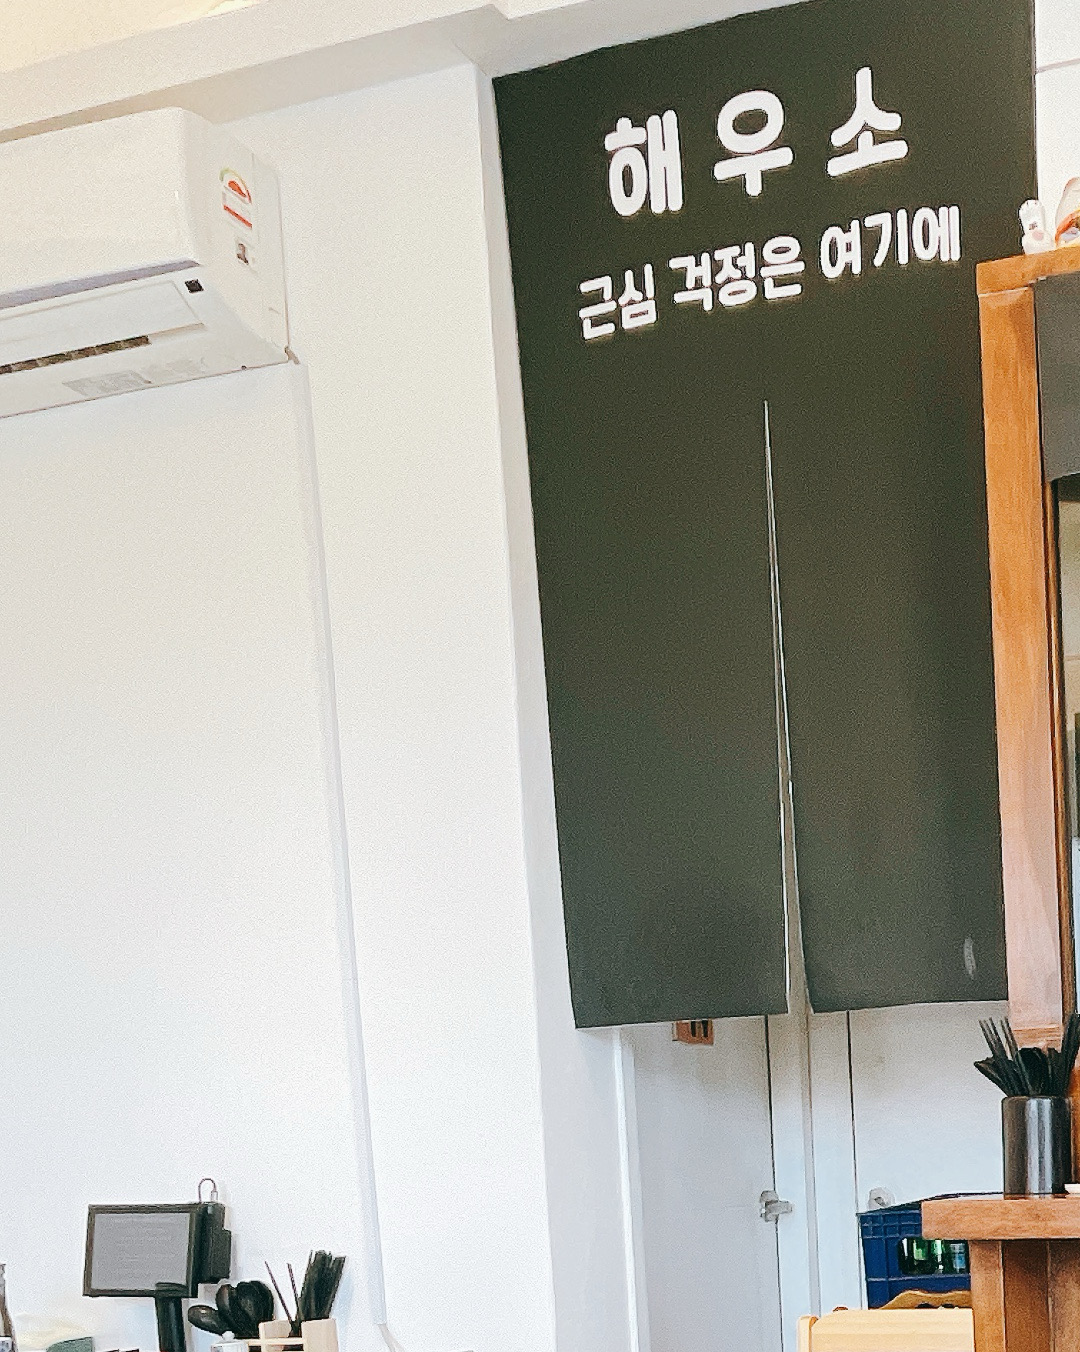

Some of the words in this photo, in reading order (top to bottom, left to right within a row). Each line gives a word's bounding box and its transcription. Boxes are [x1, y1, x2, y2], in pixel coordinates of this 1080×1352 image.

[578, 262, 658, 340] 근심
[668, 235, 806, 312] 걱정은
[819, 205, 962, 279] 여기에
